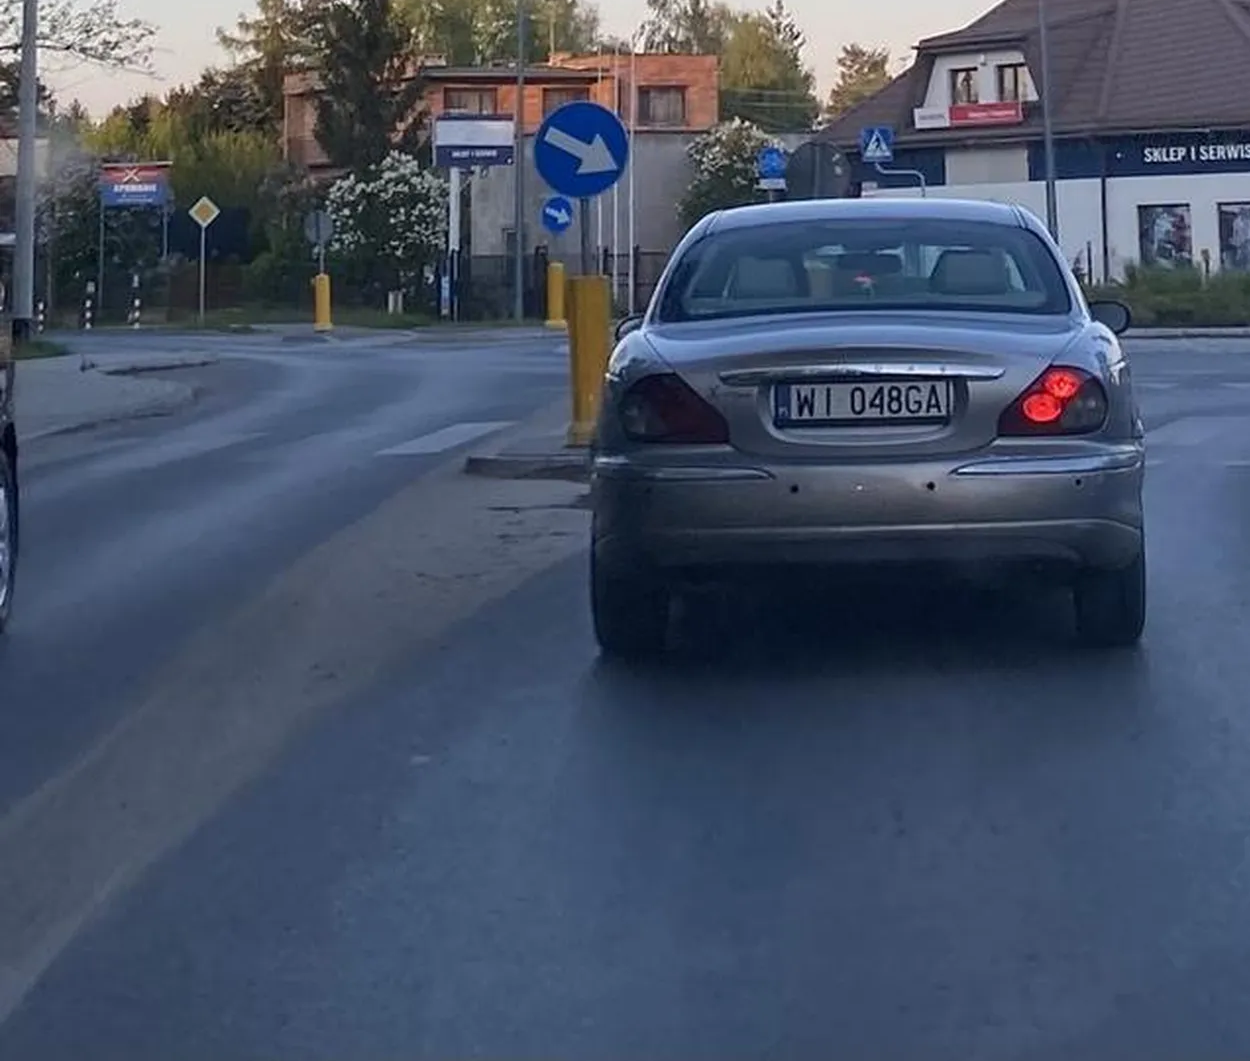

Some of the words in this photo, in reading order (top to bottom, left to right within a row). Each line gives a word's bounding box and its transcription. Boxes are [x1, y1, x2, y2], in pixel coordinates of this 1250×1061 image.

[1144, 147, 1187, 162] SKLEP
[1190, 145, 1196, 161] I
[796, 387, 831, 417] WI
[850, 385, 942, 416] 048GA
